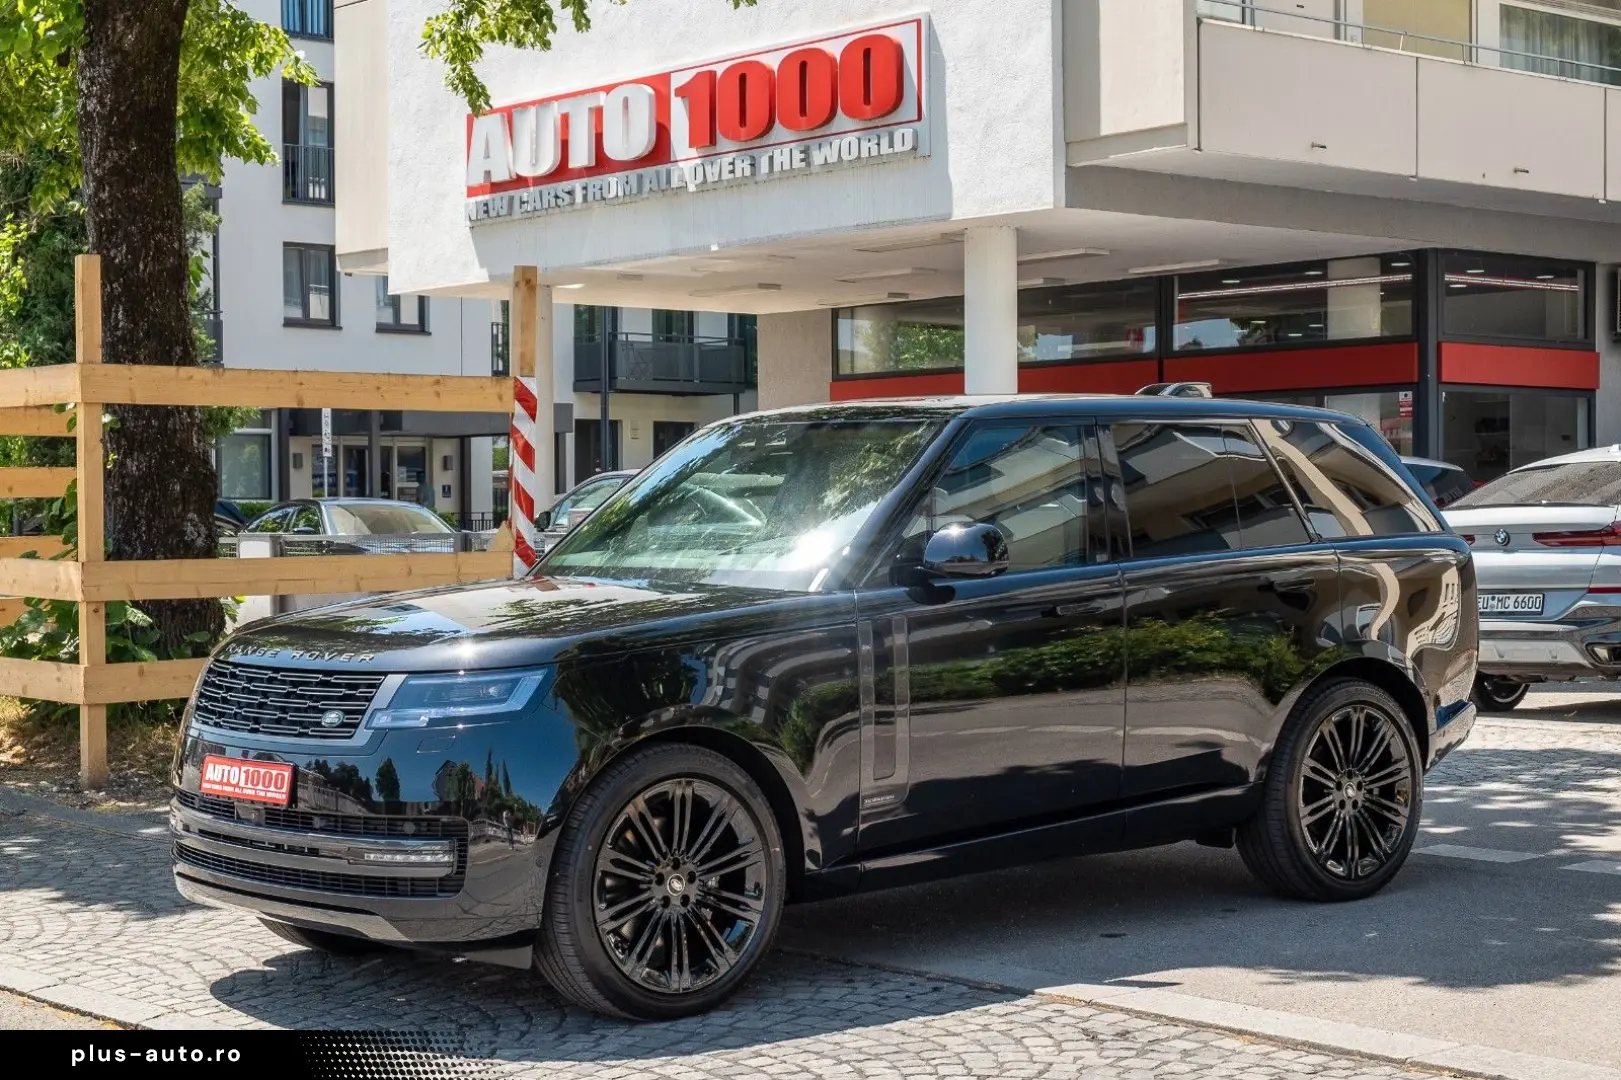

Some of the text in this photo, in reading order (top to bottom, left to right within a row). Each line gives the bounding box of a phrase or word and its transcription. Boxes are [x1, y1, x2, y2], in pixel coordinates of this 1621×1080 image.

[467, 33, 904, 184] AUTO 1000
[466, 129, 918, 221] NEW CARS FROM ALL OVER THE WORLD
[1496, 596, 1511, 609] MC
[1513, 596, 1541, 609] 6600
[226, 643, 375, 664] RANGE ROVER
[205, 763, 286, 790] AUTO 1000
